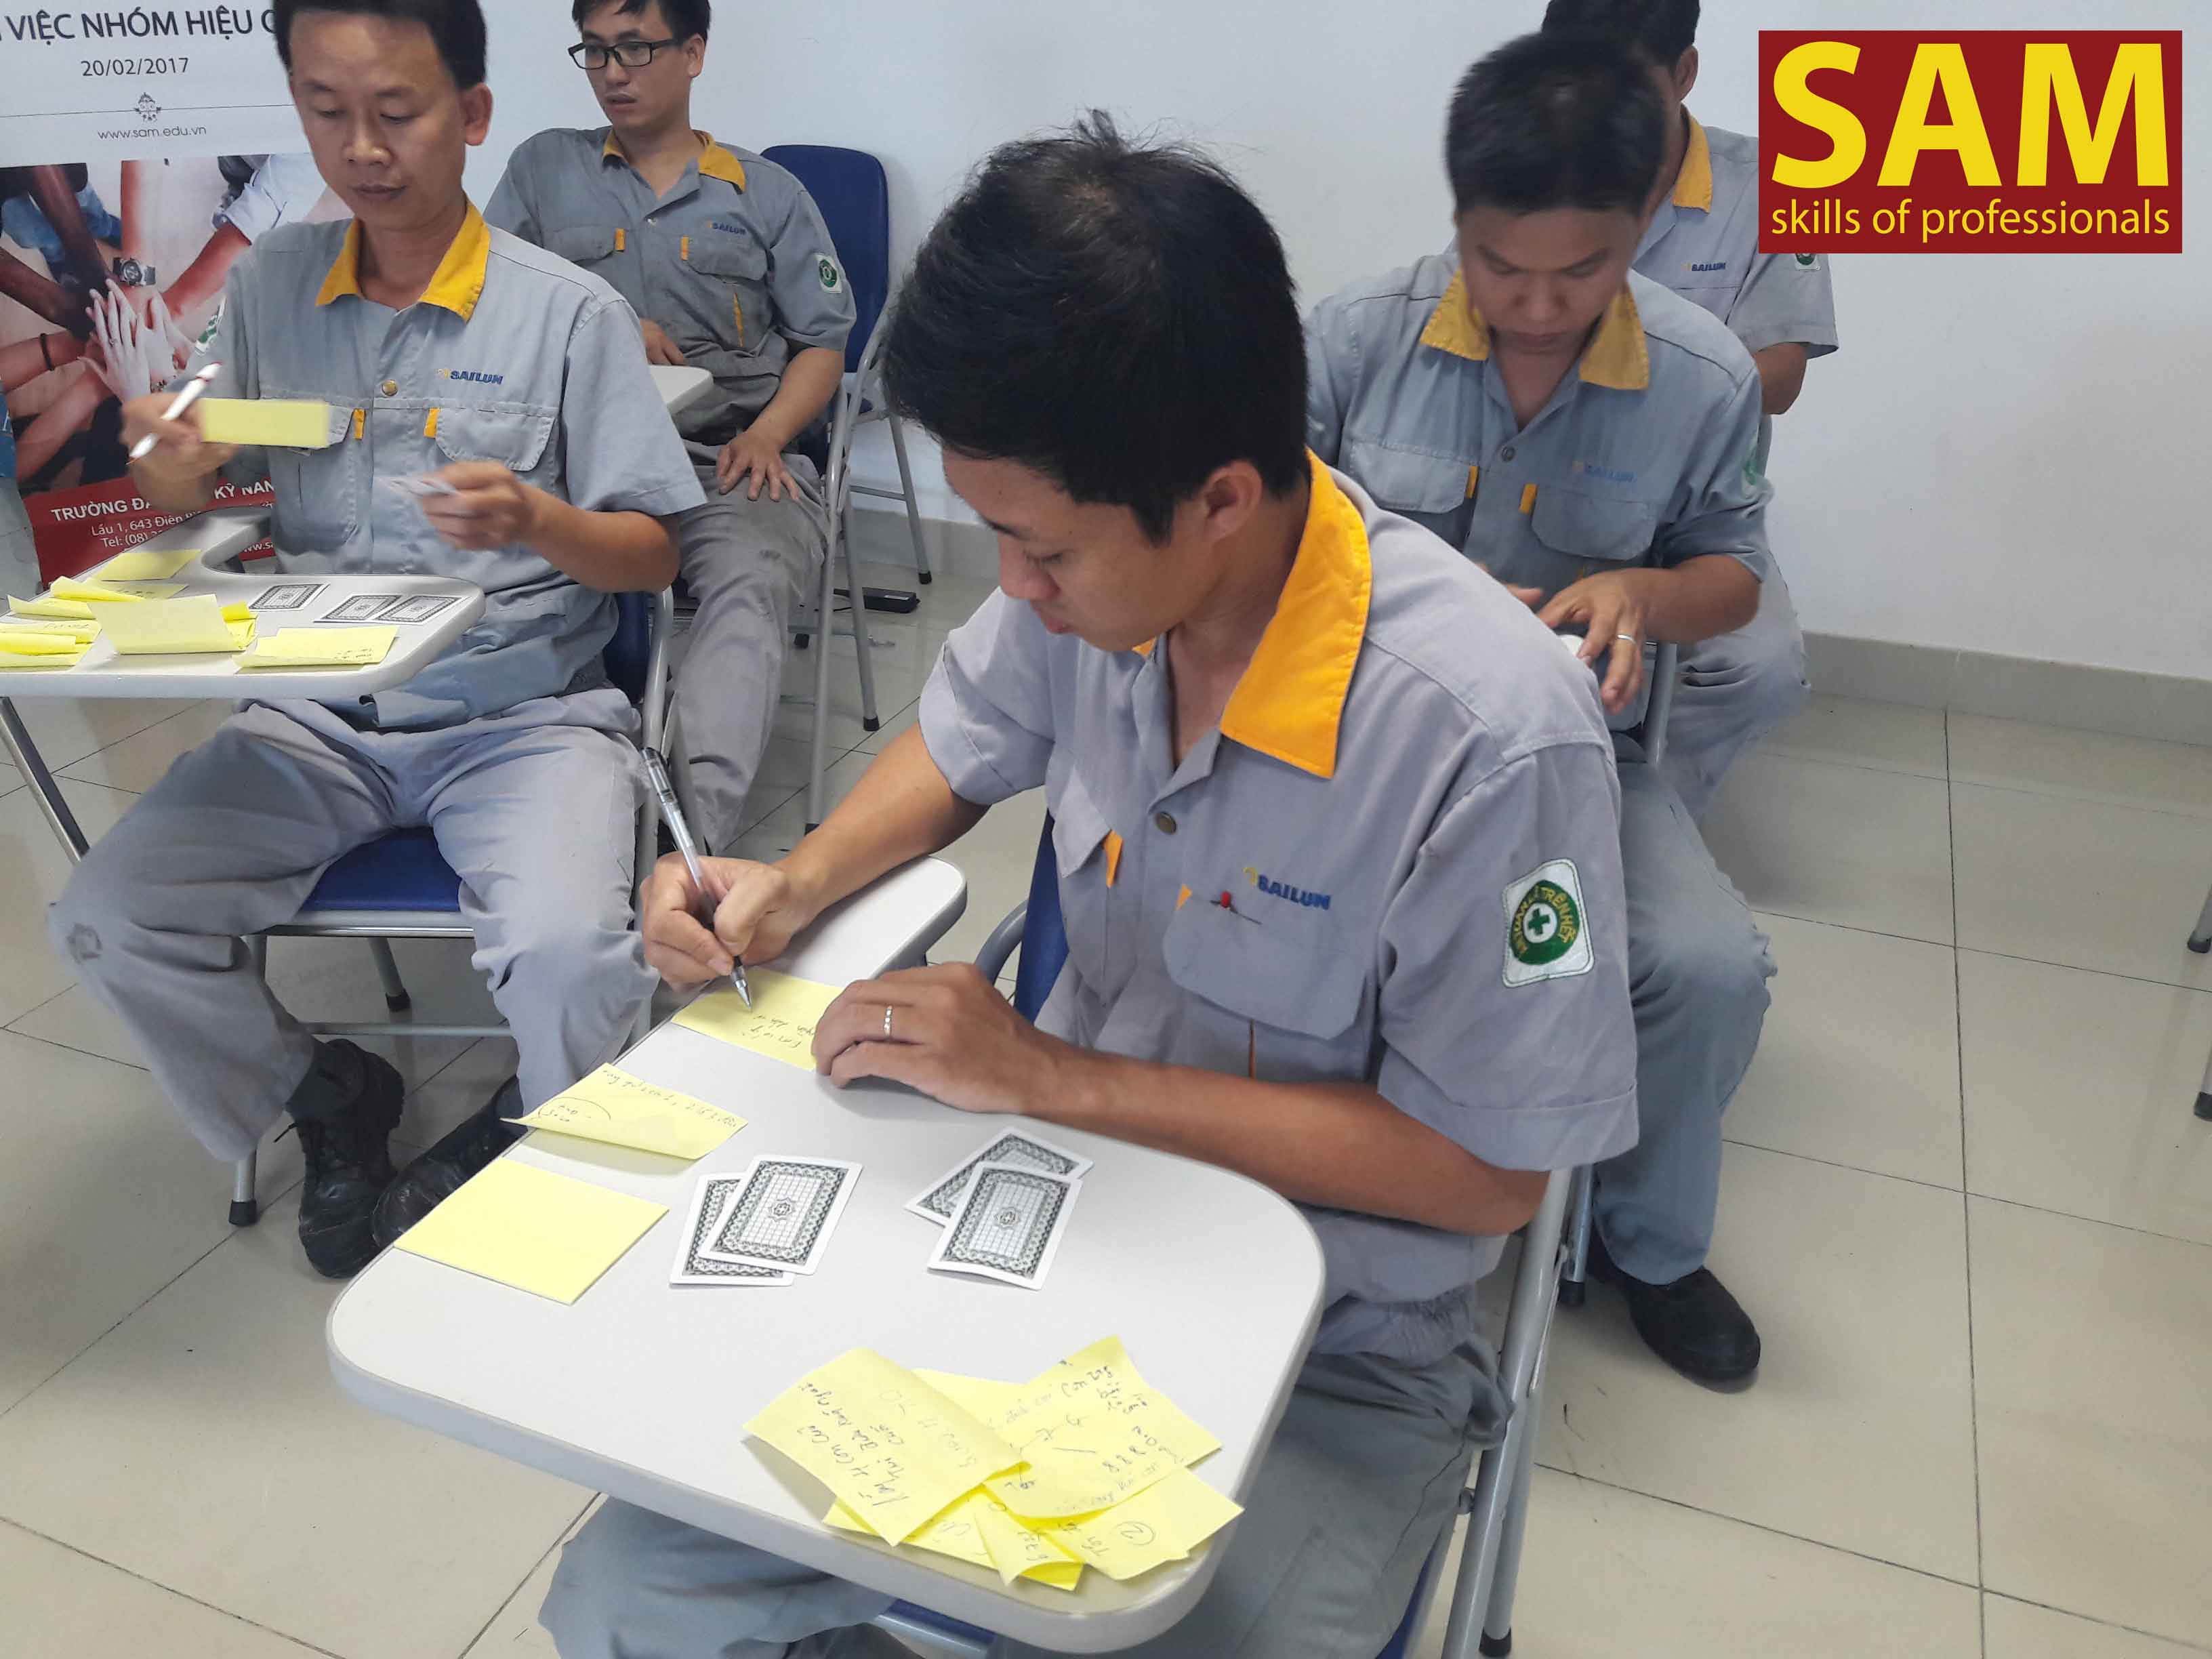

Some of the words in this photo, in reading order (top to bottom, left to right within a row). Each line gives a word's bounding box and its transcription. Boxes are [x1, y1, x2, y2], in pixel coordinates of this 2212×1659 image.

[5, 9, 75, 45] VIỆC
[81, 7, 179, 38] NHÓM
[185, 5, 253, 40] HIỆU
[81, 57, 189, 77] 20/02/2017
[97, 125, 207, 140] www.sam.edu.vn
[51, 499, 128, 522] TRƯỜNG
[129, 518, 152, 531] 643
[101, 537, 123, 548] Tel:
